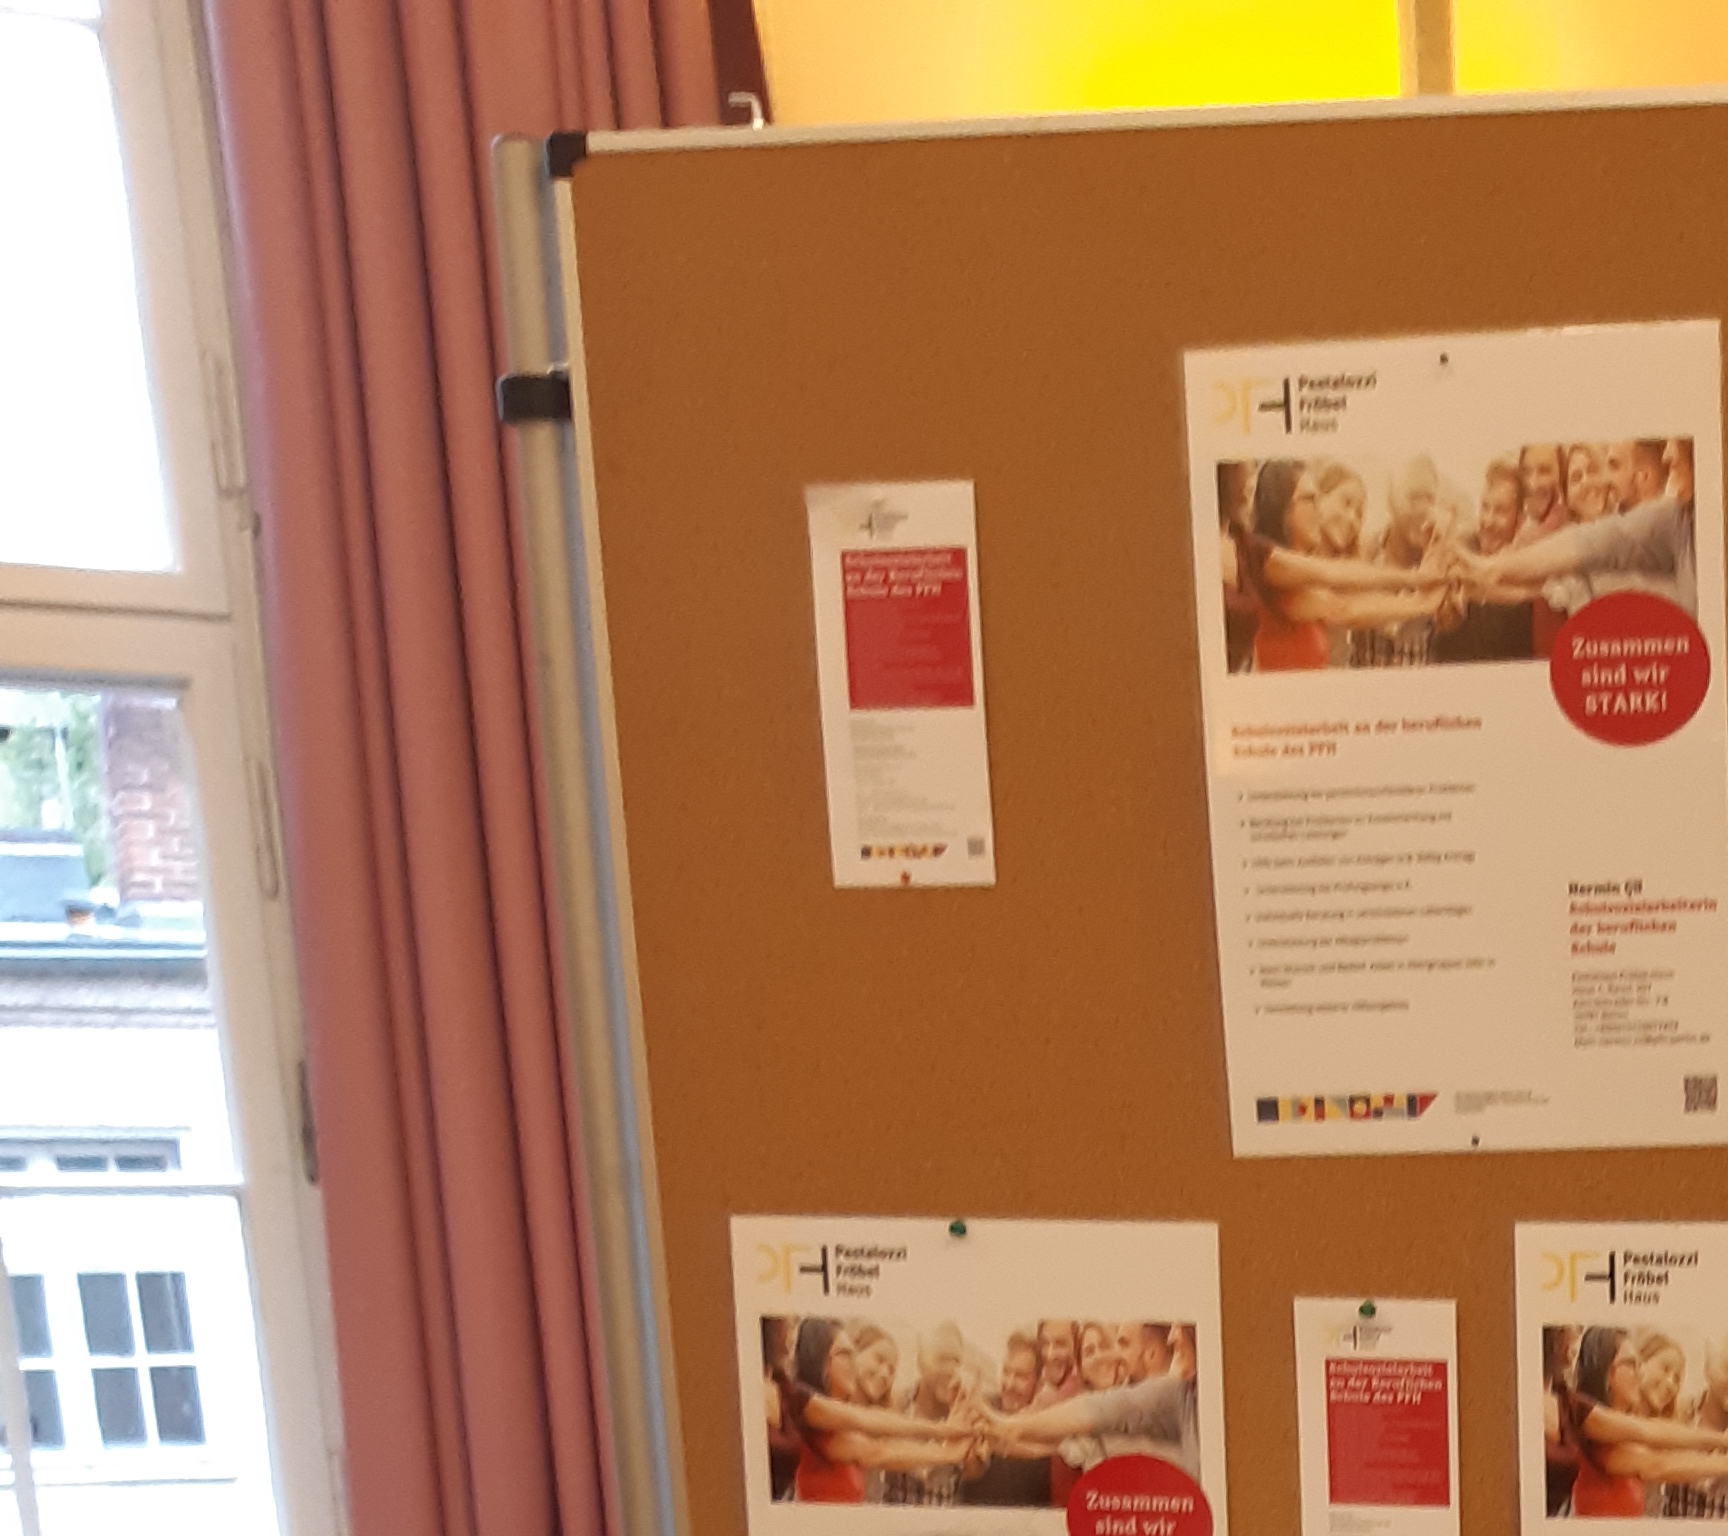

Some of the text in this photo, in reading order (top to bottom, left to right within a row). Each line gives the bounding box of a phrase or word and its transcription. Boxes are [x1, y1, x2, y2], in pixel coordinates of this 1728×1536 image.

[1572, 635, 1689, 660] Zusammen
[1581, 661, 1670, 688] sind wir
[1585, 689, 1667, 717] STARK!
[1623, 1250, 1698, 1268] Pestalozzi
[1086, 1489, 1194, 1514] Zusammen
[1095, 1514, 1137, 1536] sind
